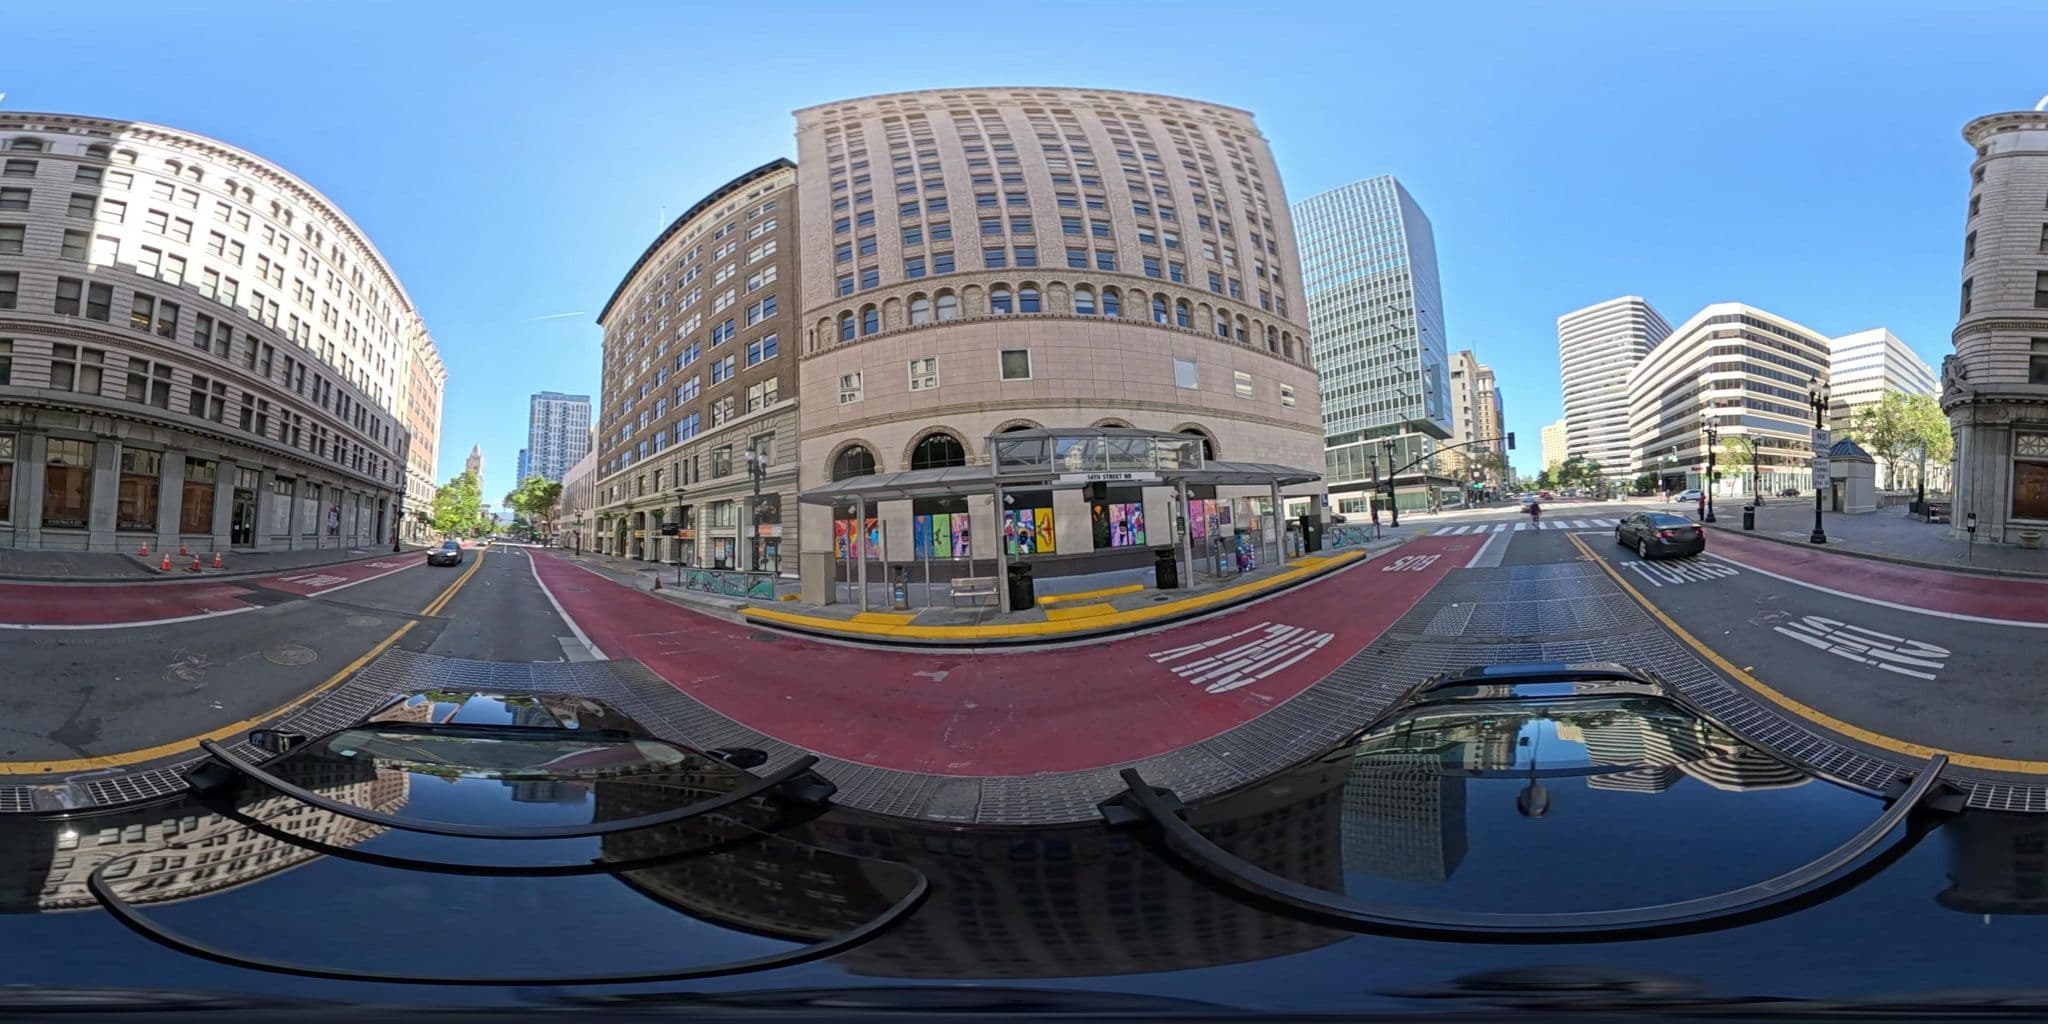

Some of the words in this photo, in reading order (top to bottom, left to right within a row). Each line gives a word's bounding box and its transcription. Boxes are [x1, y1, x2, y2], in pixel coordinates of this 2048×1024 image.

[1816, 432, 1826, 441] NO
[1381, 554, 1441, 571] BUS
[1620, 555, 1739, 586] TURNS
[1149, 622, 1335, 693] ONLY
[1773, 616, 1951, 680] NO
